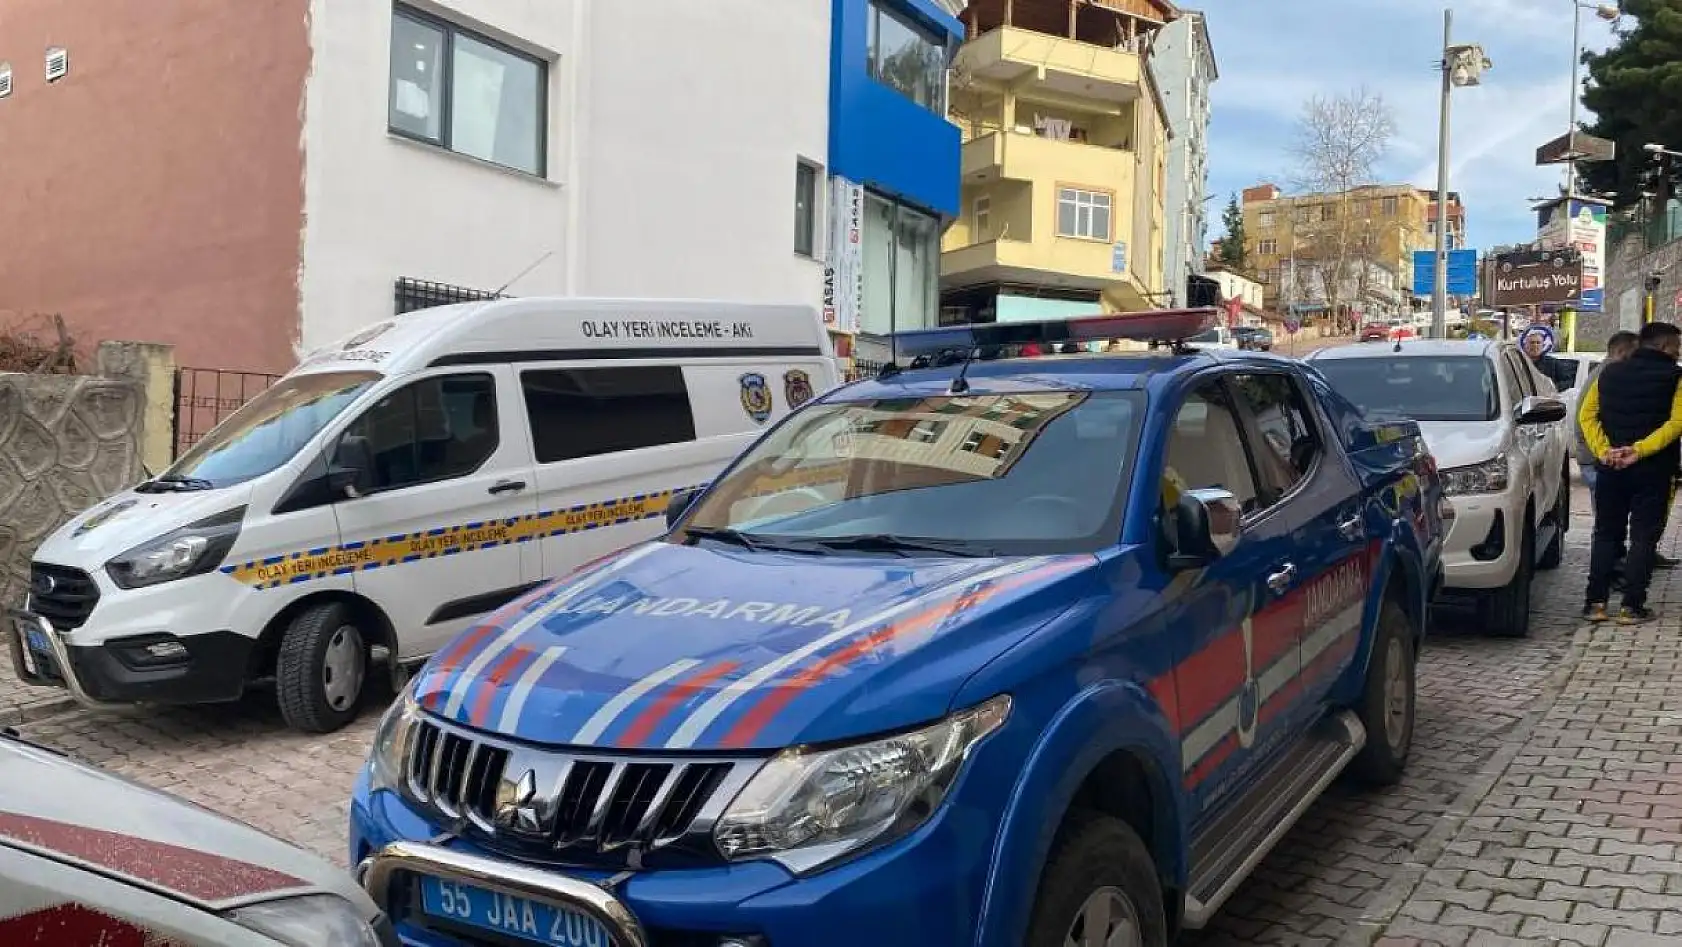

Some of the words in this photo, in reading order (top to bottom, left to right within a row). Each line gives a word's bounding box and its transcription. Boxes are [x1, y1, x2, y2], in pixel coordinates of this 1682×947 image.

[1497, 276, 1550, 290] Kurtuluş
[1551, 273, 1578, 287] Yolu
[582, 321, 618, 338] OLAY
[621, 320, 653, 338] YERİ
[656, 320, 722, 338] İNCELEME
[258, 563, 287, 579] OLAY
[556, 596, 852, 629] JANDARMA
[440, 880, 472, 918] 55
[487, 893, 538, 936] JAA
